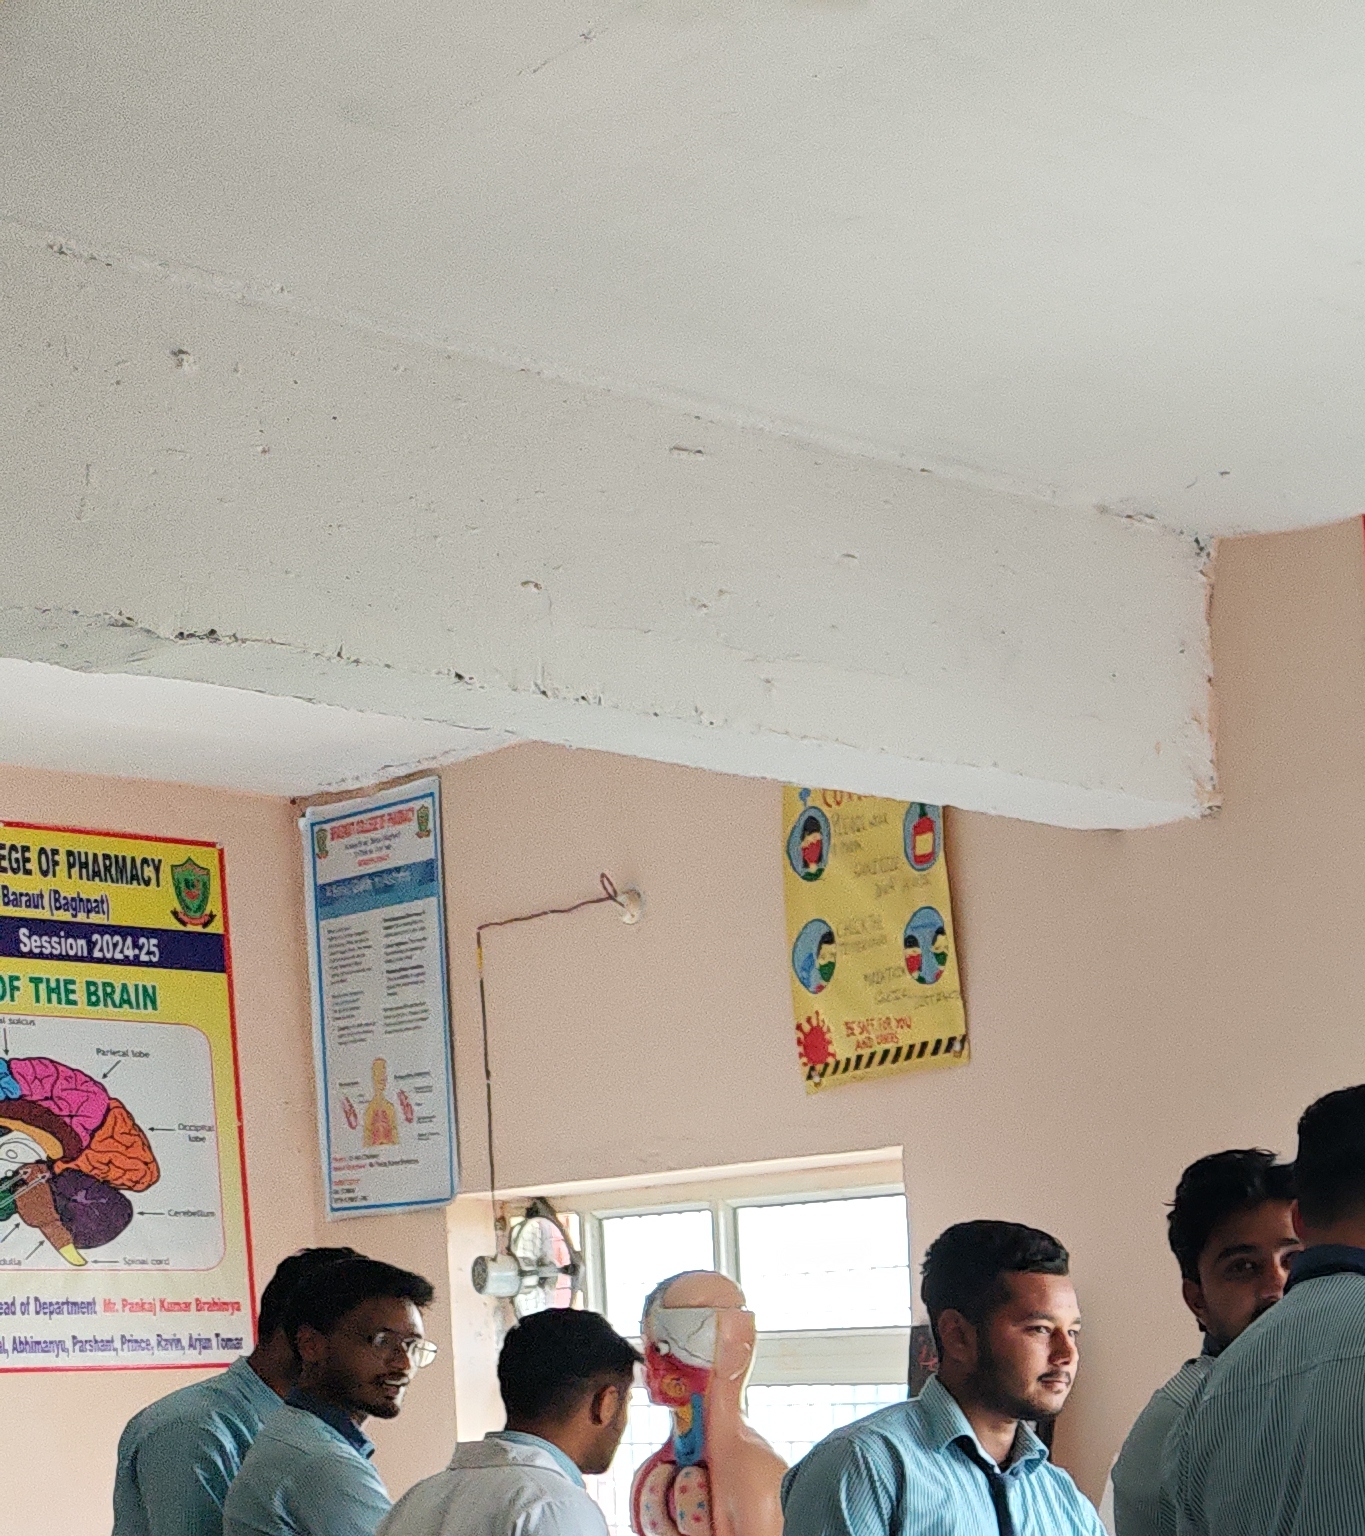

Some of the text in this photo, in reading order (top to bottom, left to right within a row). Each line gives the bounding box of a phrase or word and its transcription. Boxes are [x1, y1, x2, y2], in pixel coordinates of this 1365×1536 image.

[37, 846, 163, 888] OF PHARMACY
[1, 883, 110, 922] Baraut (Baghpat)
[18, 927, 160, 963] Session 2024-25
[28, 975, 159, 1012] THE BRAIN
[20, 1296, 31, 1316] of
[33, 1295, 97, 1321] Department
[159, 1298, 192, 1313] Kumar
[12, 1335, 71, 1359] Abhimanyu,
[71, 1334, 119, 1357] Parshant,
[120, 1333, 155, 1356] Prince,
